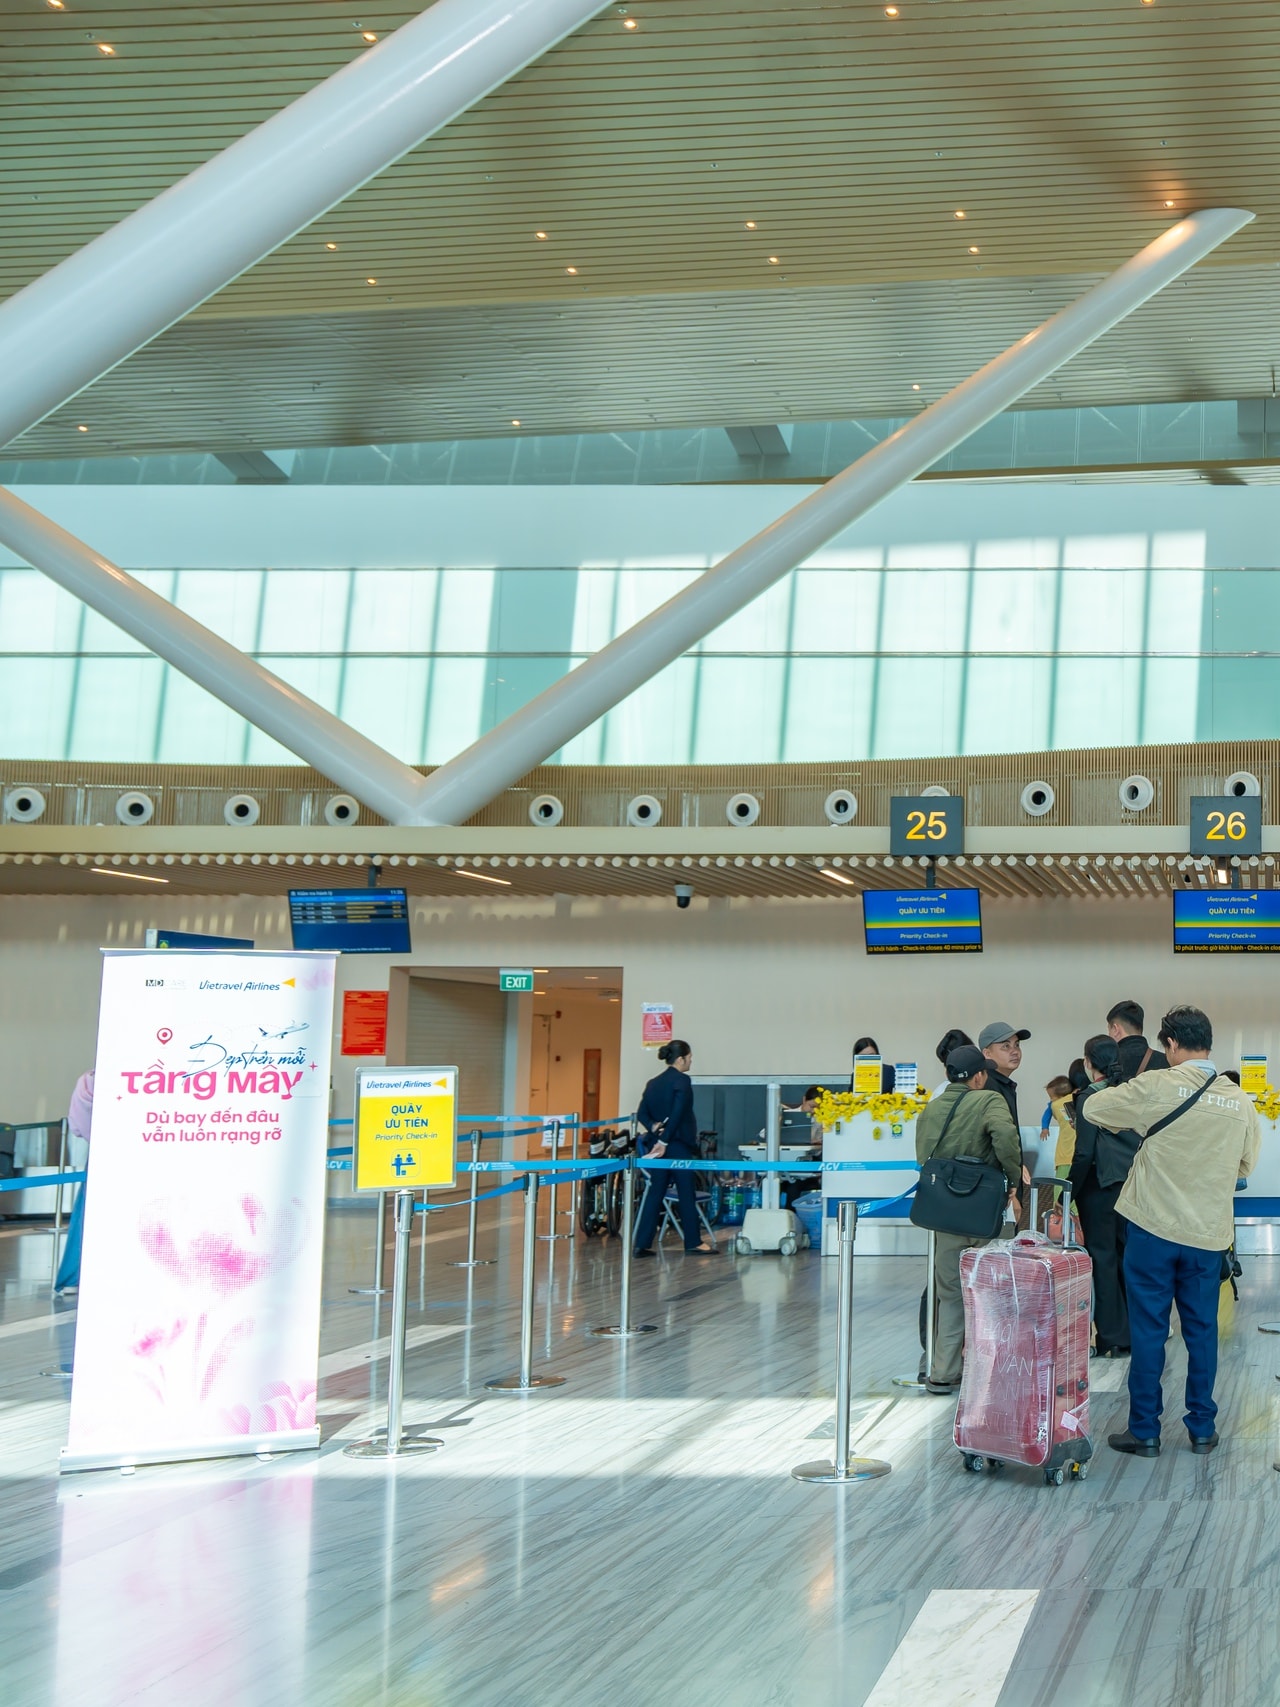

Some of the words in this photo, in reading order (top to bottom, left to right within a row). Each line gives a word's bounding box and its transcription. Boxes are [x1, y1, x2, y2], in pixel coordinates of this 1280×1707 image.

[905, 811, 947, 840] 25
[1206, 811, 1246, 840] 26
[199, 980, 242, 990] Vietravel
[244, 981, 280, 991] Airlines
[506, 977, 527, 988] EXIT
[366, 1081, 402, 1089] Vietravel
[402, 1080, 432, 1089] Airlines
[391, 1102, 422, 1116] QUẦY
[146, 1110, 170, 1123] Dù
[174, 1111, 207, 1127] bay
[210, 1107, 242, 1123] đến
[246, 1110, 279, 1123] đâu
[404, 1116, 429, 1128] TIÊN
[142, 1126, 175, 1142] vẫn
[180, 1128, 217, 1142] luôn
[221, 1130, 260, 1144] rạng
[264, 1128, 282, 1141] rỡ
[375, 1134, 404, 1142] Priority
[406, 1132, 438, 1140] Check-in
[468, 1162, 490, 1171] ACV
[671, 1160, 692, 1169] ACV
[819, 1162, 840, 1171] ACV
